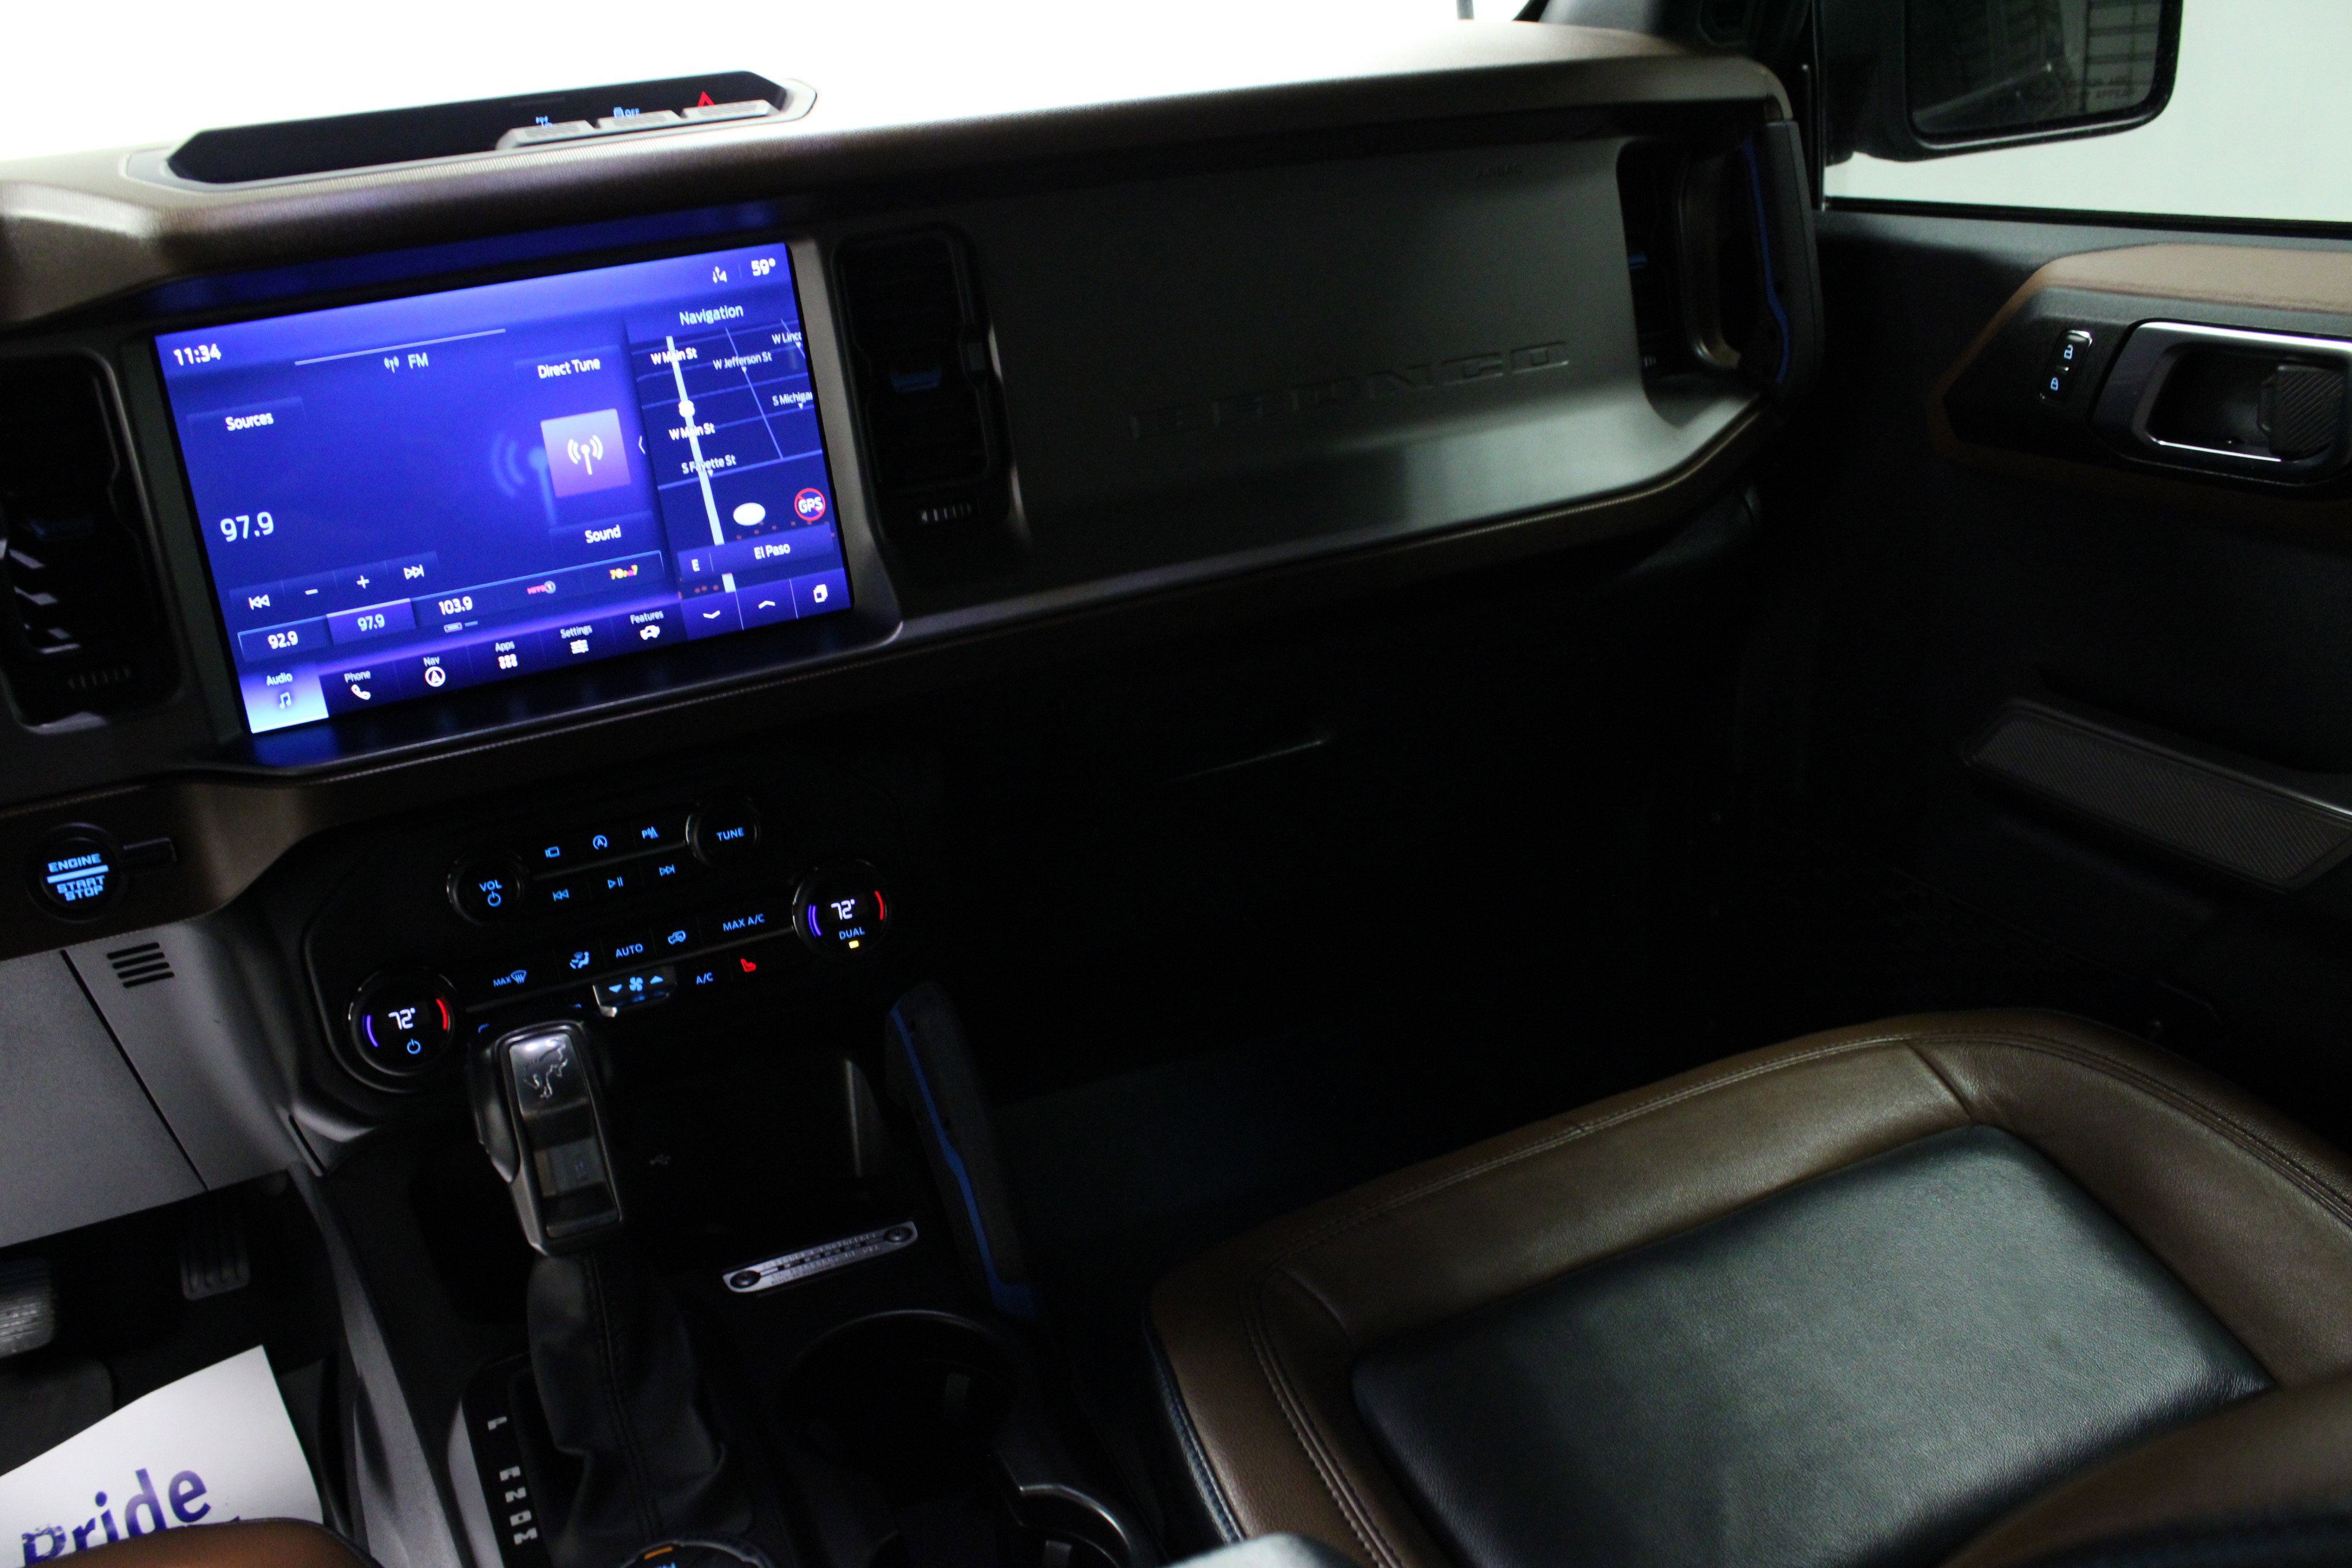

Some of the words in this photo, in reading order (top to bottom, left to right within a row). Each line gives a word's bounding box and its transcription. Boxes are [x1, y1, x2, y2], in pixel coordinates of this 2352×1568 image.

[680, 303, 744, 326] Navigation
[772, 334, 781, 344] W
[173, 343, 222, 366] 11:34
[407, 352, 429, 370] FM
[651, 352, 662, 365] W
[661, 349, 686, 362] Main
[685, 347, 698, 360] St
[713, 358, 723, 370] W
[723, 352, 762, 368] Jefferson
[762, 351, 772, 362] St
[538, 360, 571, 379] Direct
[571, 357, 601, 374] Tune
[772, 395, 779, 406] S
[226, 412, 274, 432] Sources
[668, 429, 680, 440] W
[680, 426, 703, 438] Main
[703, 423, 716, 435] St
[681, 462, 689, 475] S
[689, 457, 725, 475] Fayette
[724, 455, 736, 466] St
[798, 495, 824, 514] GPS
[220, 511, 274, 542] 97.9
[584, 524, 622, 543] Sound
[691, 558, 700, 572] E
[753, 547, 766, 560] El
[766, 543, 791, 558] Paso
[267, 631, 298, 649] 92.9
[357, 613, 385, 631] 97.9
[438, 596, 473, 615] 103.9
[266, 672, 293, 686] Audio
[344, 669, 371, 683] Phone
[423, 656, 440, 667] Nav
[495, 641, 515, 653] Apps
[560, 624, 592, 639] Settings
[630, 610, 664, 625] Features
[716, 827, 744, 841] TUNE
[48, 853, 102, 873] ENGINE
[57, 875, 105, 894] START
[65, 886, 103, 901] STOP
[479, 880, 502, 892] VOL
[723, 920, 745, 932] MAX
[747, 913, 766, 925] A/C
[838, 927, 865, 940] DUAL
[615, 943, 643, 959] AUTO
[493, 976, 511, 987] MAX
[695, 972, 714, 985] A/C
